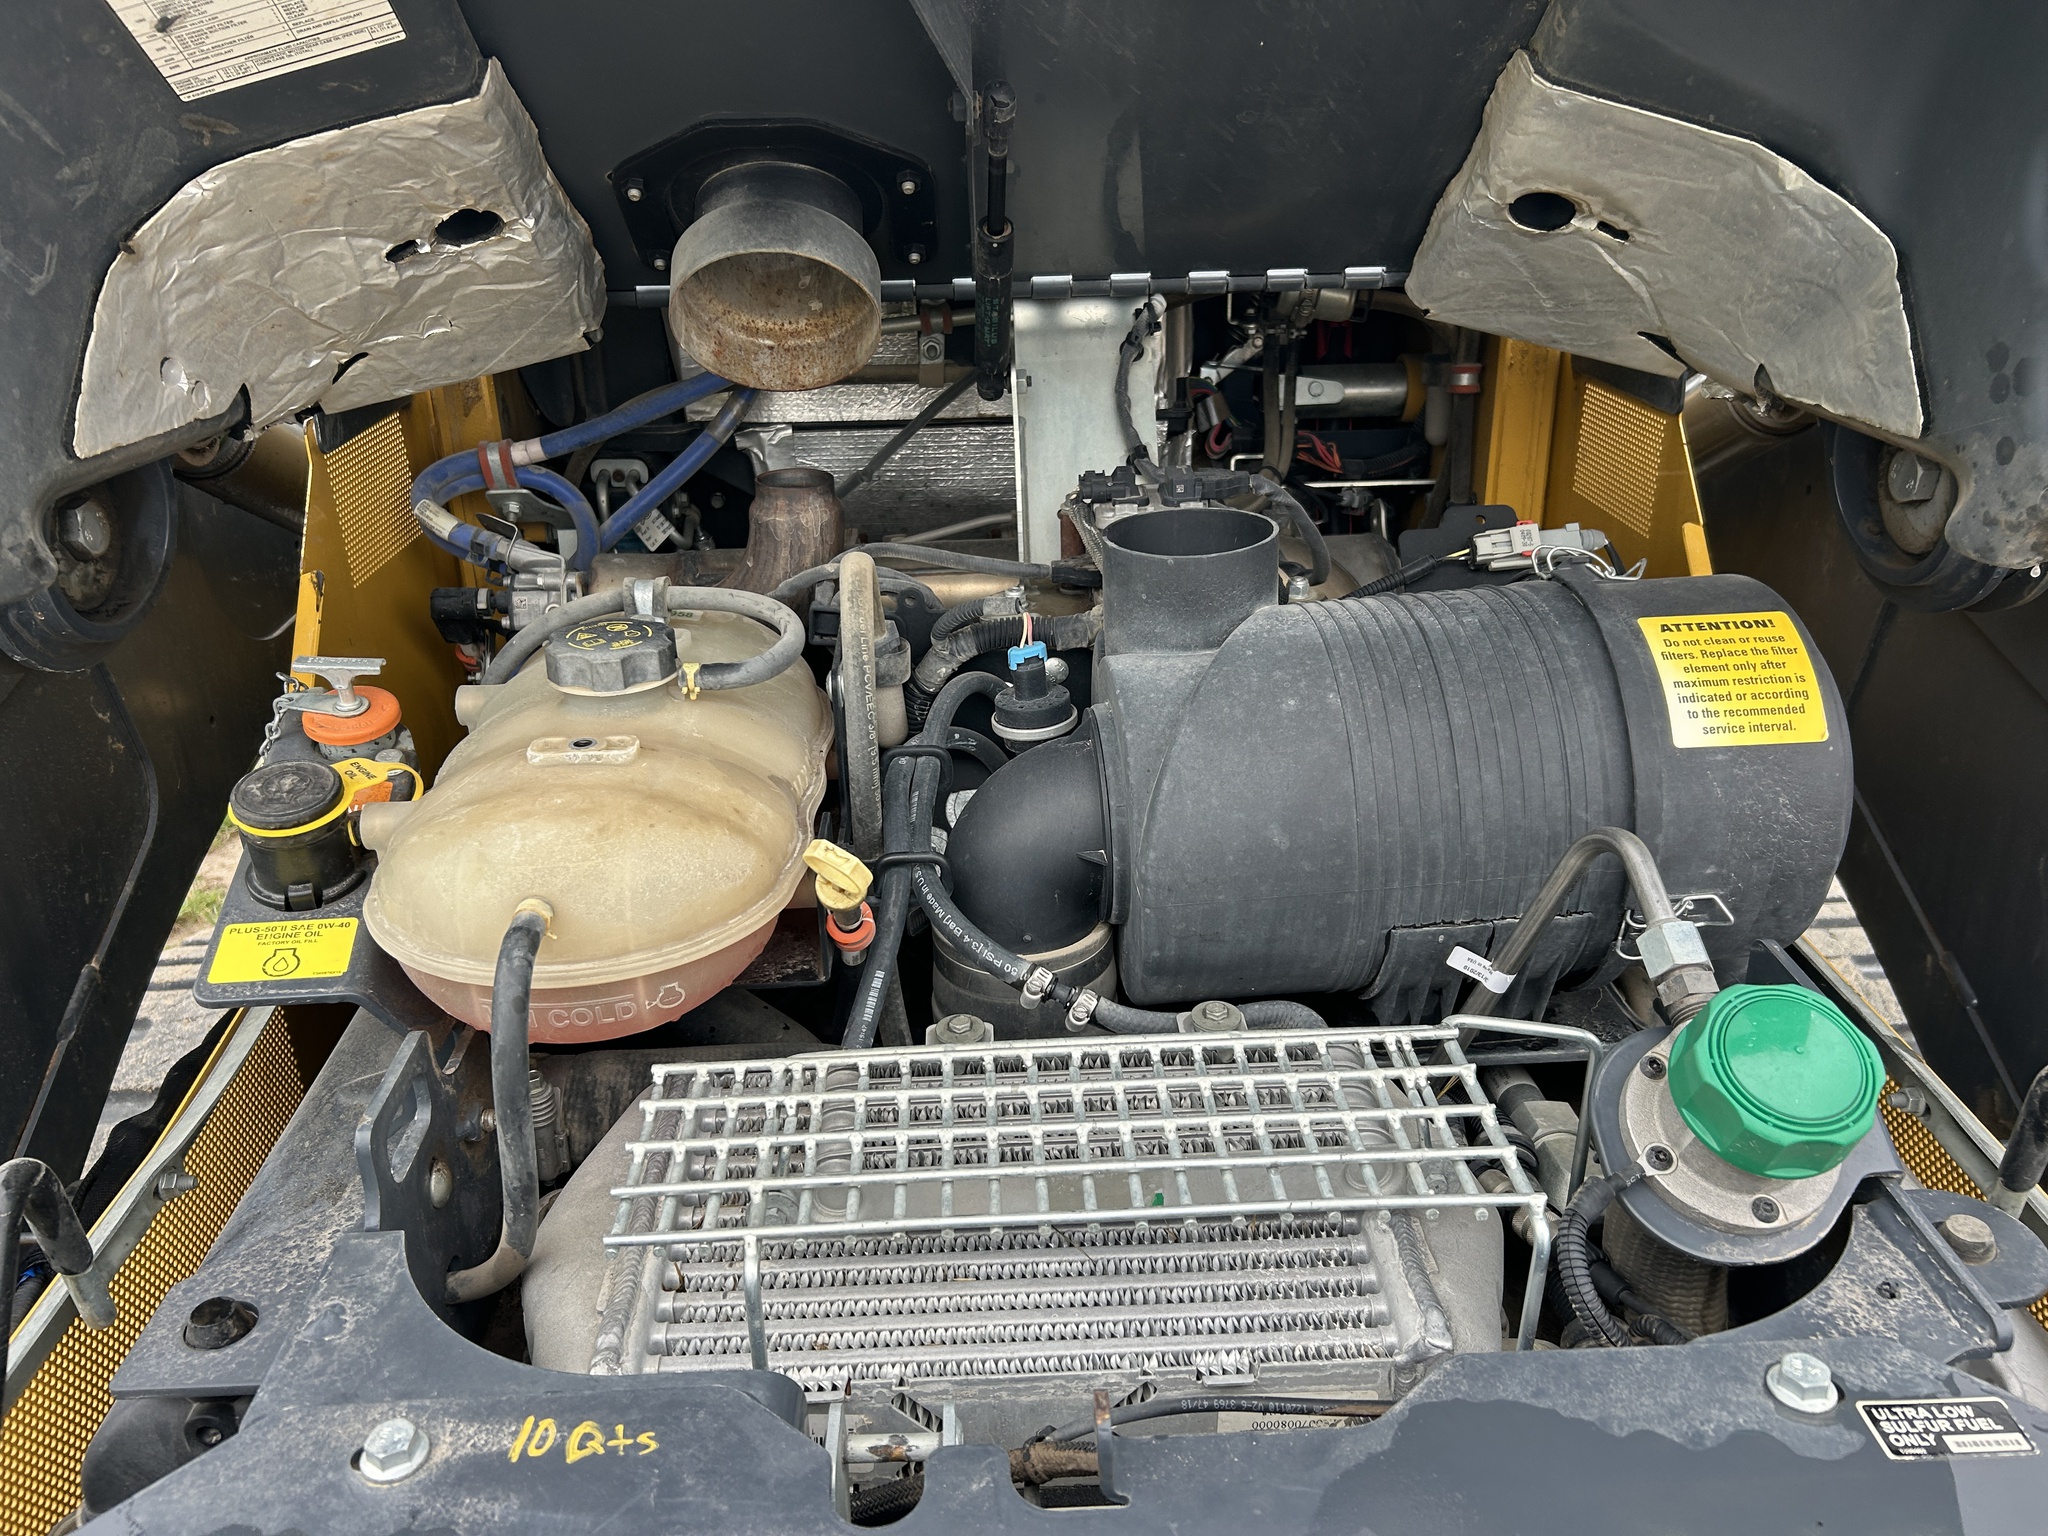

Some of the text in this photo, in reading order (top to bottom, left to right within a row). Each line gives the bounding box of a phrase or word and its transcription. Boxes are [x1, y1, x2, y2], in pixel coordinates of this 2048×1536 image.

[1660, 619, 1776, 633] ATTENTION!
[1663, 635, 1786, 648] Do not clean or reuse
[1661, 646, 1798, 660] filters. Replace the filter
[1683, 660, 1787, 674] element only after
[1673, 673, 1806, 688] maximum restriction is
[1677, 689, 1809, 704] indicated or according
[1687, 703, 1806, 719] to the recommended
[1702, 720, 1796, 735] service interval.
[344, 769, 357, 780] OIL
[350, 761, 377, 781] ENGINE
[926, 893, 945, 918] Made
[290, 923, 314, 931] SAE
[317, 922, 351, 930] 0W-40
[256, 930, 323, 940] ENGINE OIL
[982, 950, 1003, 968] PSI
[1004, 964, 1018, 976] 50
[548, 1001, 637, 1028] COLD
[1181, 1399, 1209, 1410] 47/18
[1214, 1400, 1236, 1410] 3769
[1871, 1405, 1975, 1420] ULTRA LOW
[1880, 1417, 2004, 1434] SULFUR FUEL
[508, 1415, 660, 1464] 10 Qts
[1888, 1434, 1937, 1447] ONLY
